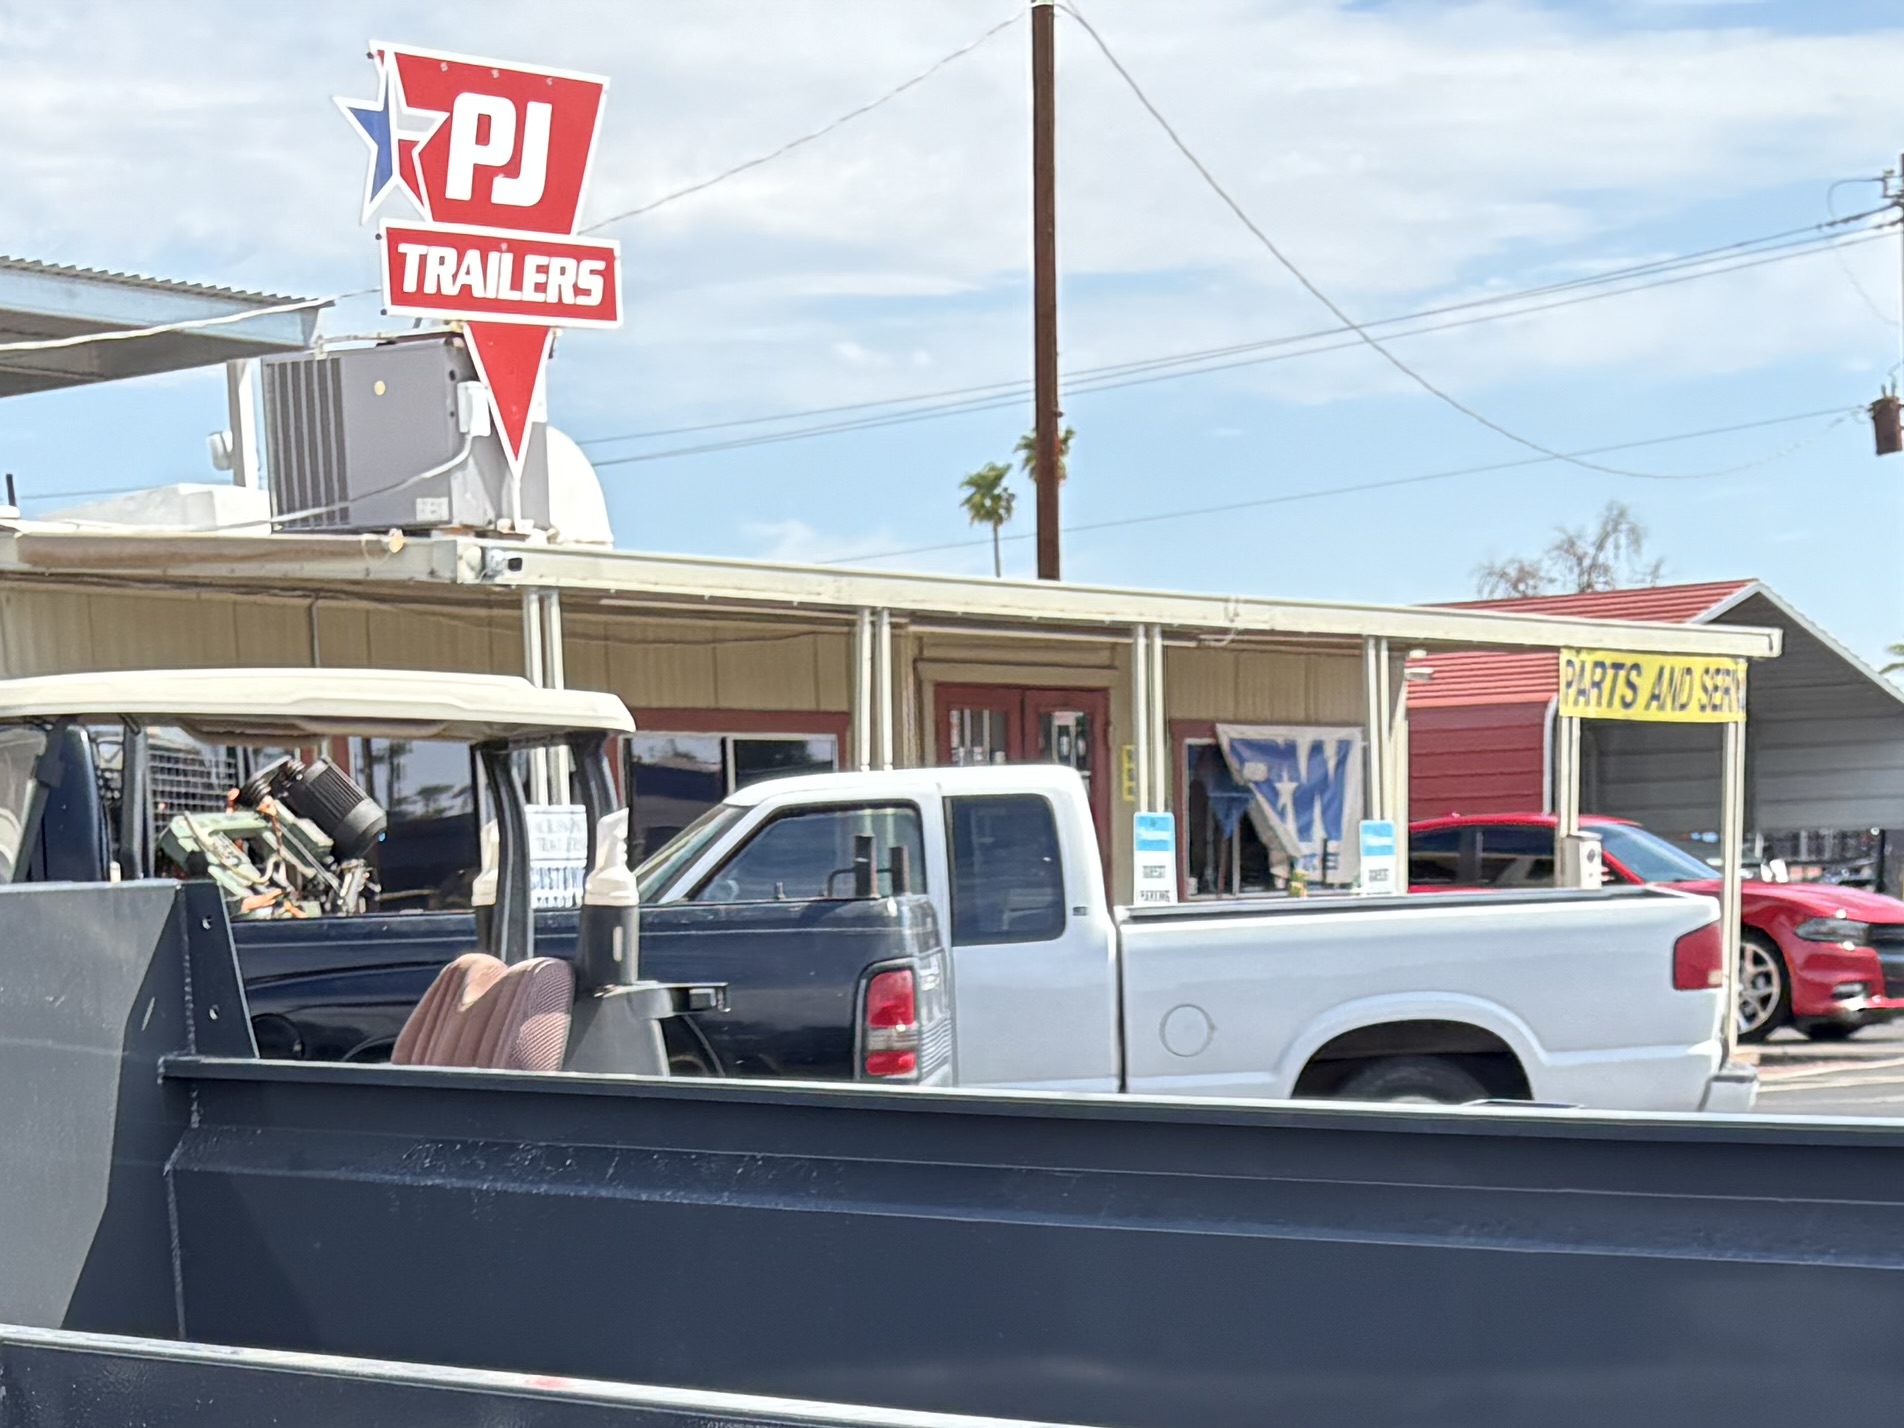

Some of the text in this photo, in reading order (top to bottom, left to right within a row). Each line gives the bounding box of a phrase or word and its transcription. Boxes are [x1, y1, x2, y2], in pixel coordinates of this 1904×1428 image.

[445, 92, 552, 206] PJ
[398, 244, 606, 306] TRAILERS
[1564, 658, 1642, 711] PARTS
[1644, 664, 1694, 712] AND
